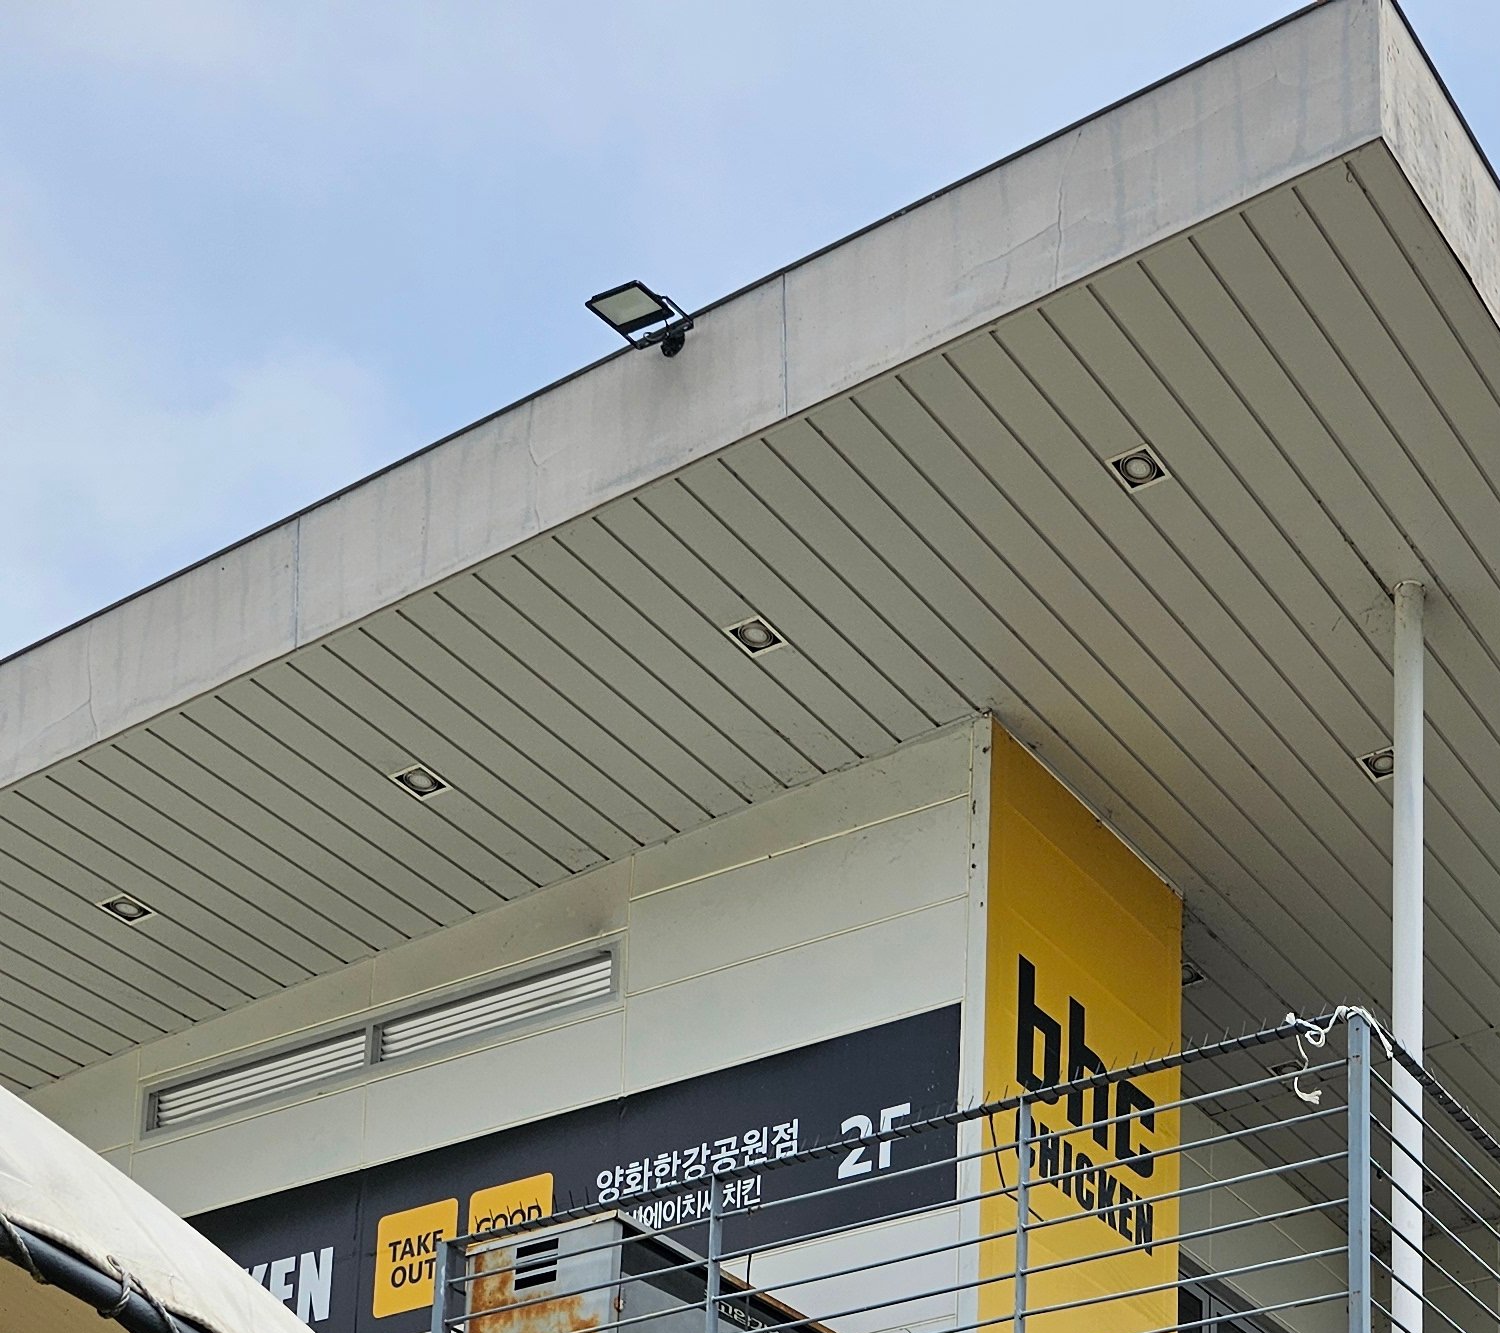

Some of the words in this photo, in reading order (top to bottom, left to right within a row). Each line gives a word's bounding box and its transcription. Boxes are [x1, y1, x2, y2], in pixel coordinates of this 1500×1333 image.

[1016, 954, 1155, 1179] bhc
[596, 1119, 800, 1203] 양화한강공원점
[838, 1103, 911, 1179] 2F
[722, 1175, 762, 1208] 치킨
[1014, 1113, 1153, 1257] CHICKEN
[389, 1229, 443, 1262] TAKE
[390, 1260, 437, 1289] OUT
